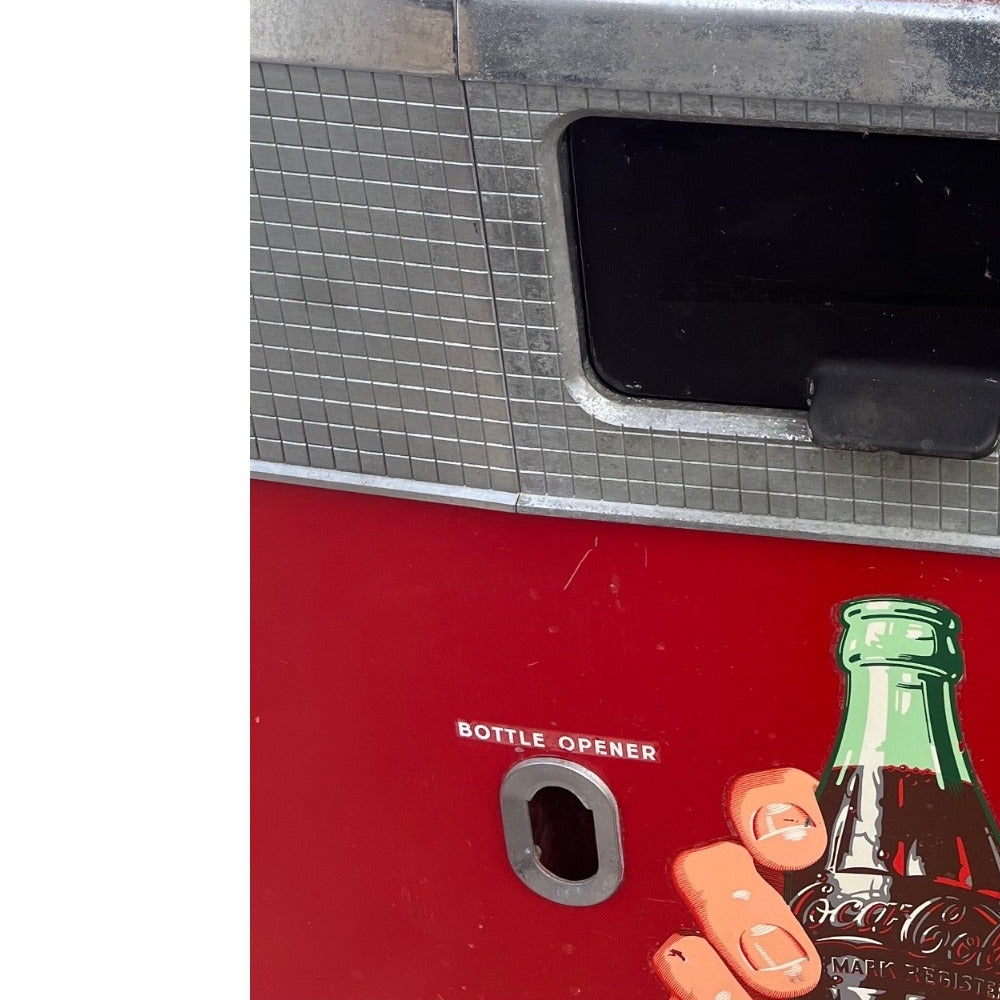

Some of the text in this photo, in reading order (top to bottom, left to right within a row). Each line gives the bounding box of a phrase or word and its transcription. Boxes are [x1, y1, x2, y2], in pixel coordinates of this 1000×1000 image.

[457, 721, 657, 761] BOTTLE OPENER
[830, 956, 897, 980] MARK
